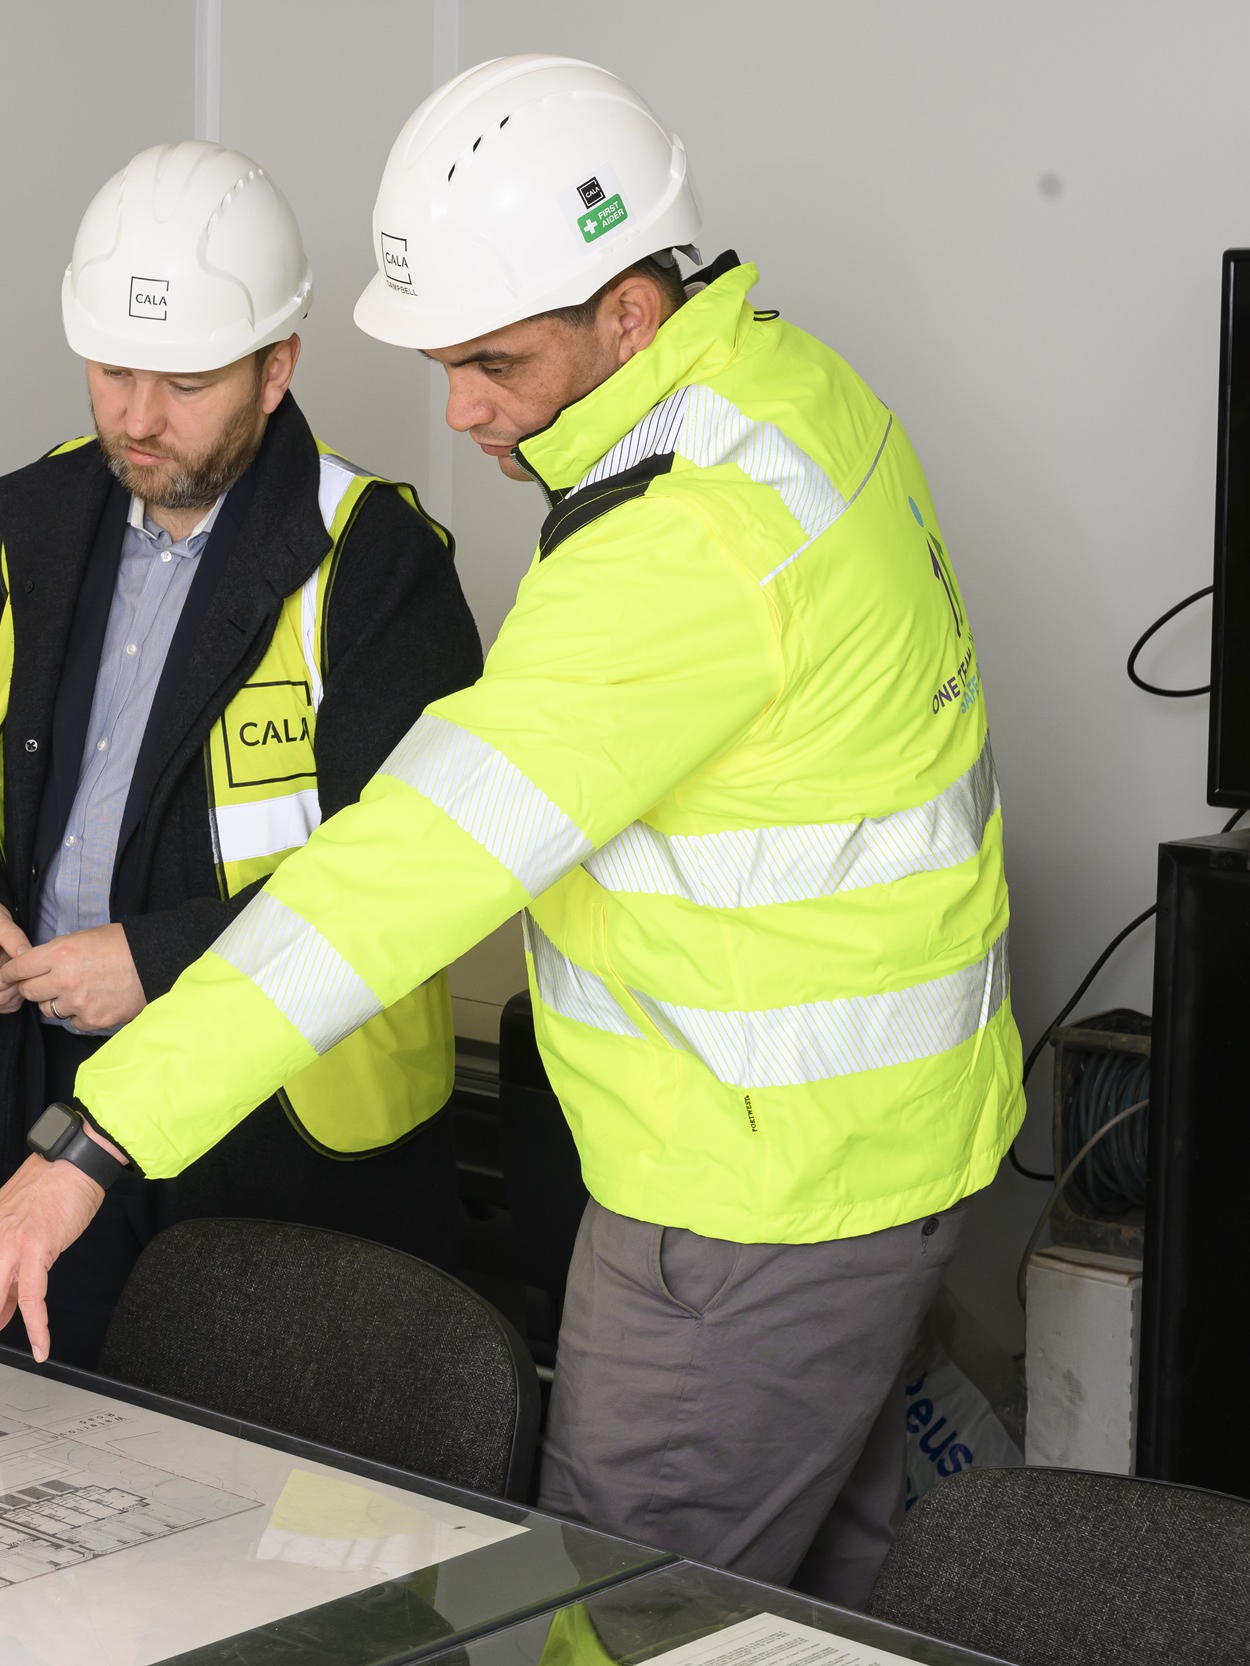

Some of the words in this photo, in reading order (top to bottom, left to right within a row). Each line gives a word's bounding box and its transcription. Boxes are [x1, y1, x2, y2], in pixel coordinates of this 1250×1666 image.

[585, 186, 601, 198] CALA
[597, 201, 620, 220] FIRST
[601, 208, 625, 228] AIDER
[385, 251, 409, 269] CALA
[135, 293, 168, 306] CALA
[932, 676, 961, 715] ONE
[239, 717, 310, 747] CALA
[905, 1371, 973, 1478] eus
